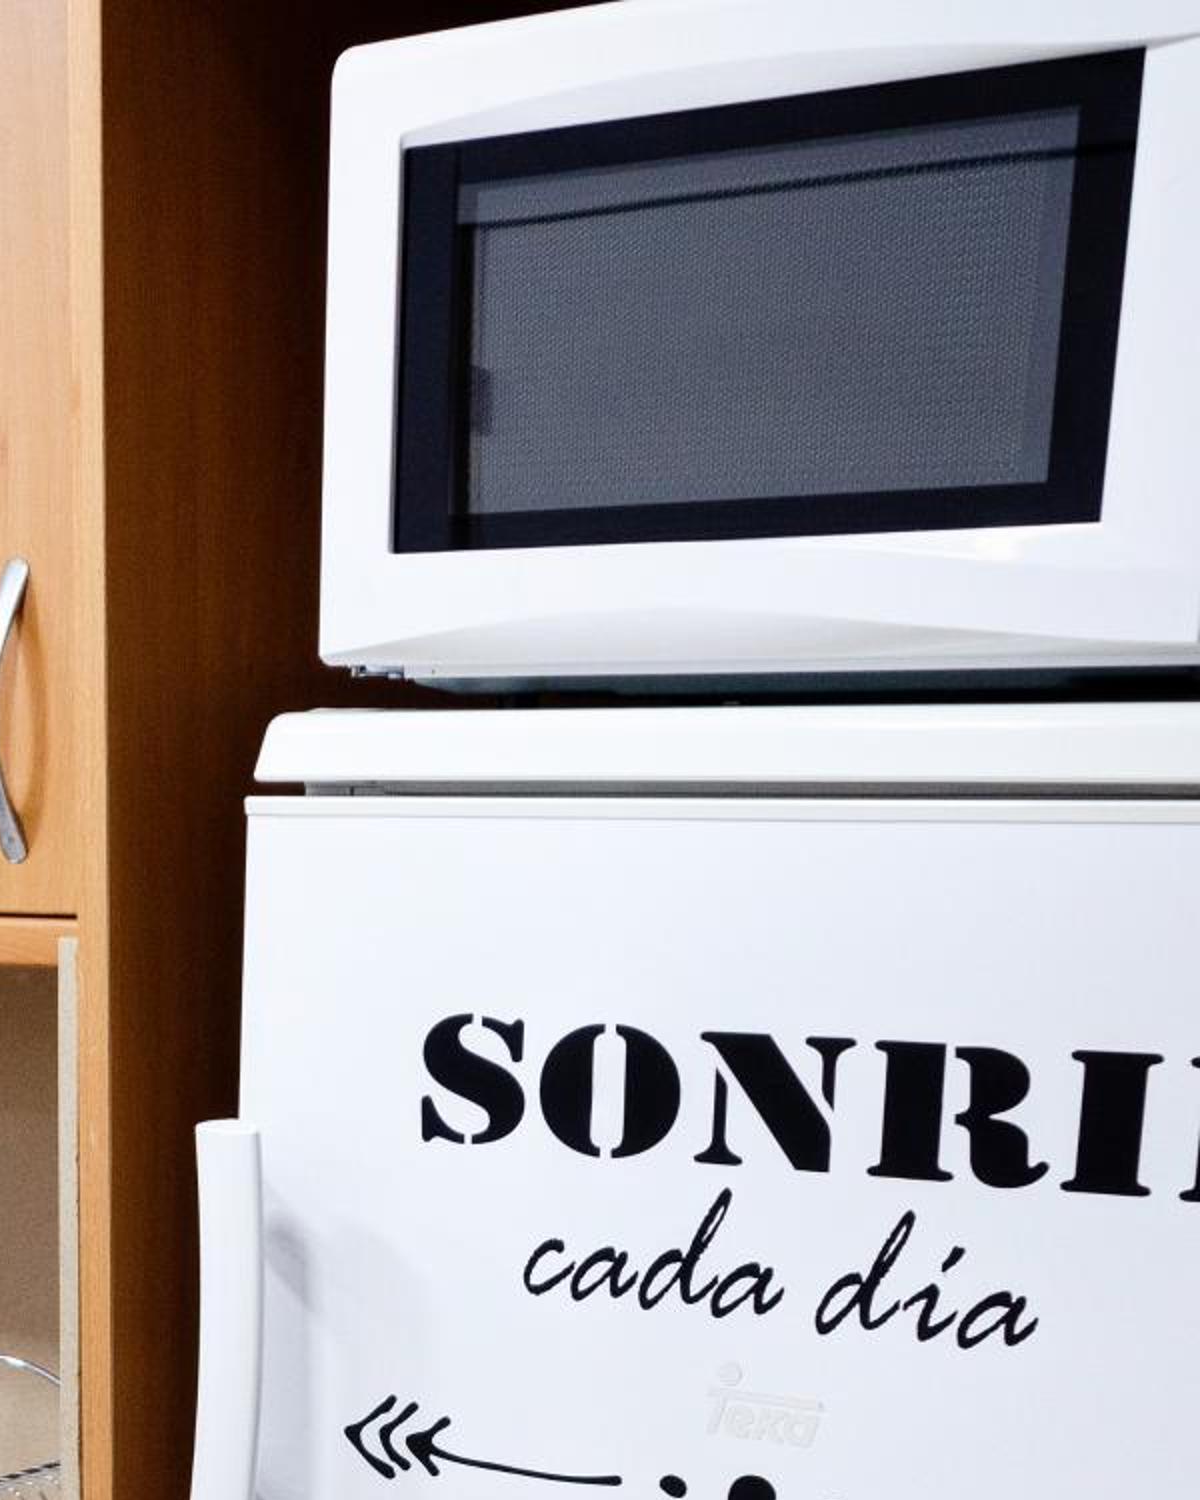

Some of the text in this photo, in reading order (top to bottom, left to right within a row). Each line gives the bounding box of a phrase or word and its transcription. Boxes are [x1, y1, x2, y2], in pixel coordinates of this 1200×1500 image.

[421, 1013, 1200, 1203] SONRI
[523, 1188, 1039, 1350] cada día
